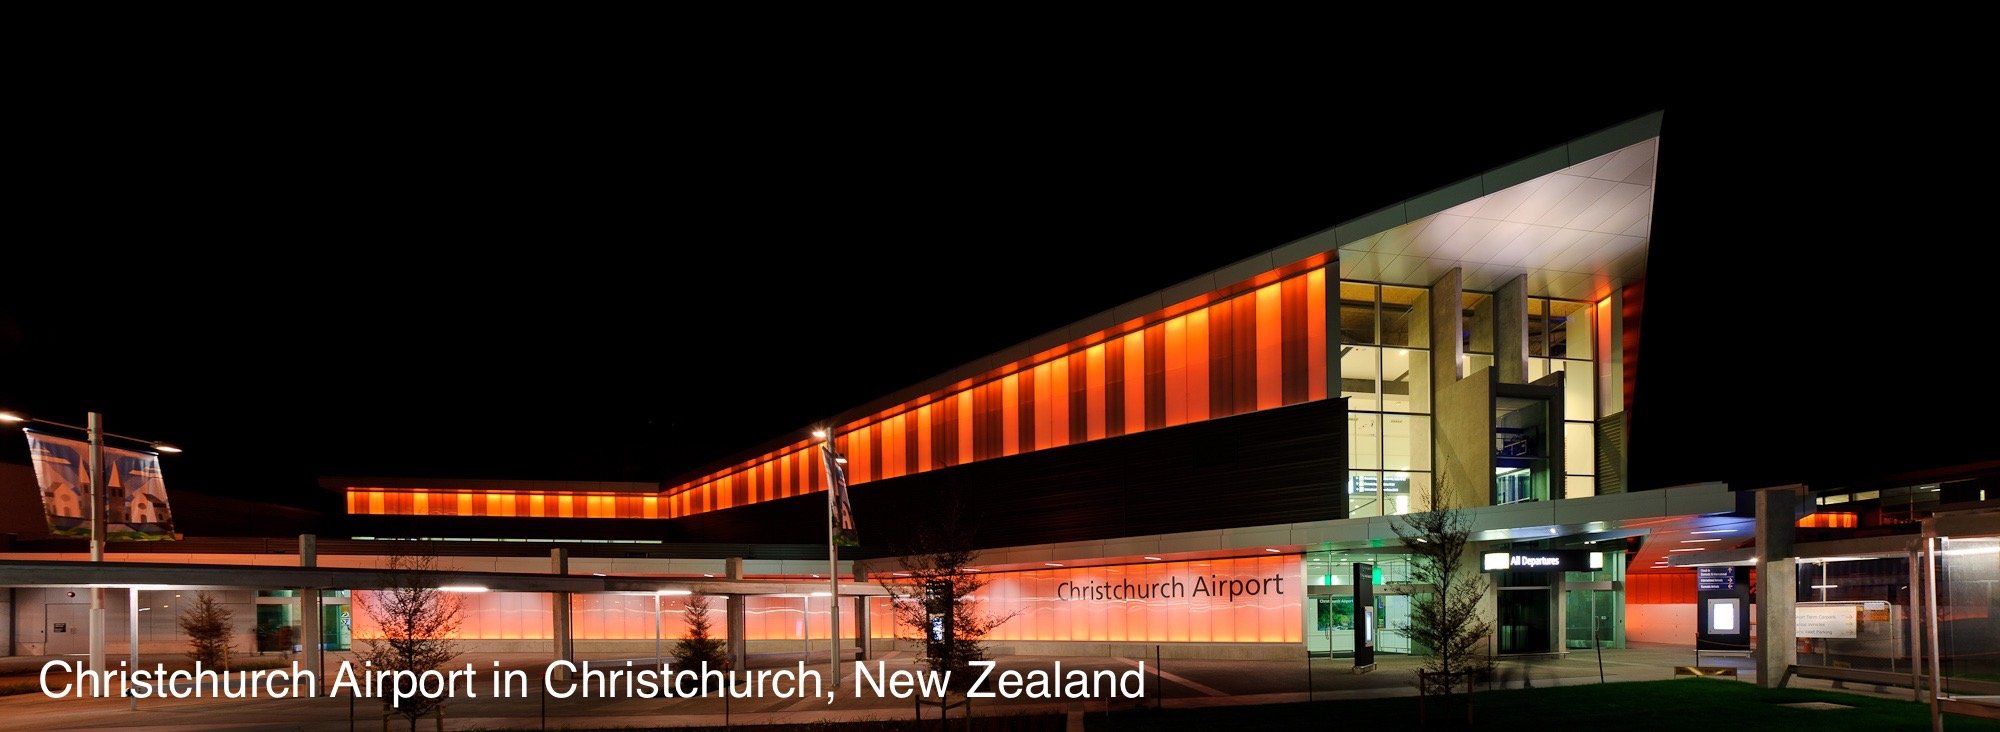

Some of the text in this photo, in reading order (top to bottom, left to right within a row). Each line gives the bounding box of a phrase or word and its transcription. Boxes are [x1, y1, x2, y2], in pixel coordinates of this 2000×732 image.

[1510, 555, 1560, 568] All Departures
[1057, 573, 1284, 602] Christchurch Airport
